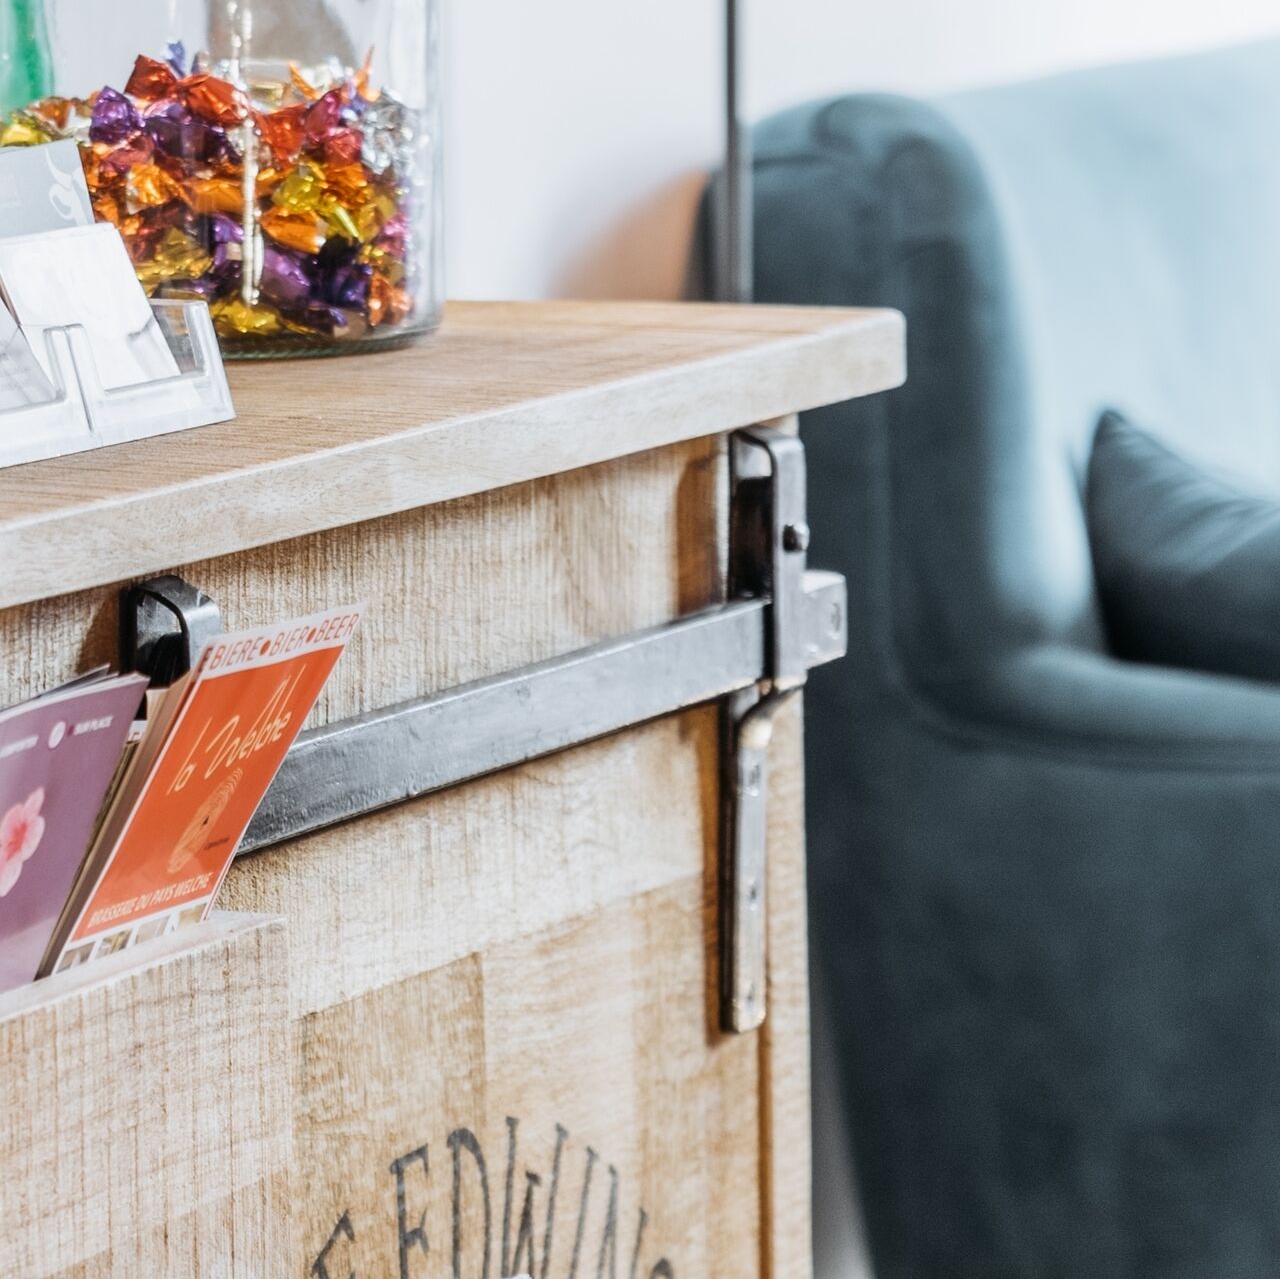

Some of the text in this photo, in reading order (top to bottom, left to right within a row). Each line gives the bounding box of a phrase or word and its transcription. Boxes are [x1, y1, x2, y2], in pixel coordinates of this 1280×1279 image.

[209, 613, 360, 670] BIERE BIER BEER
